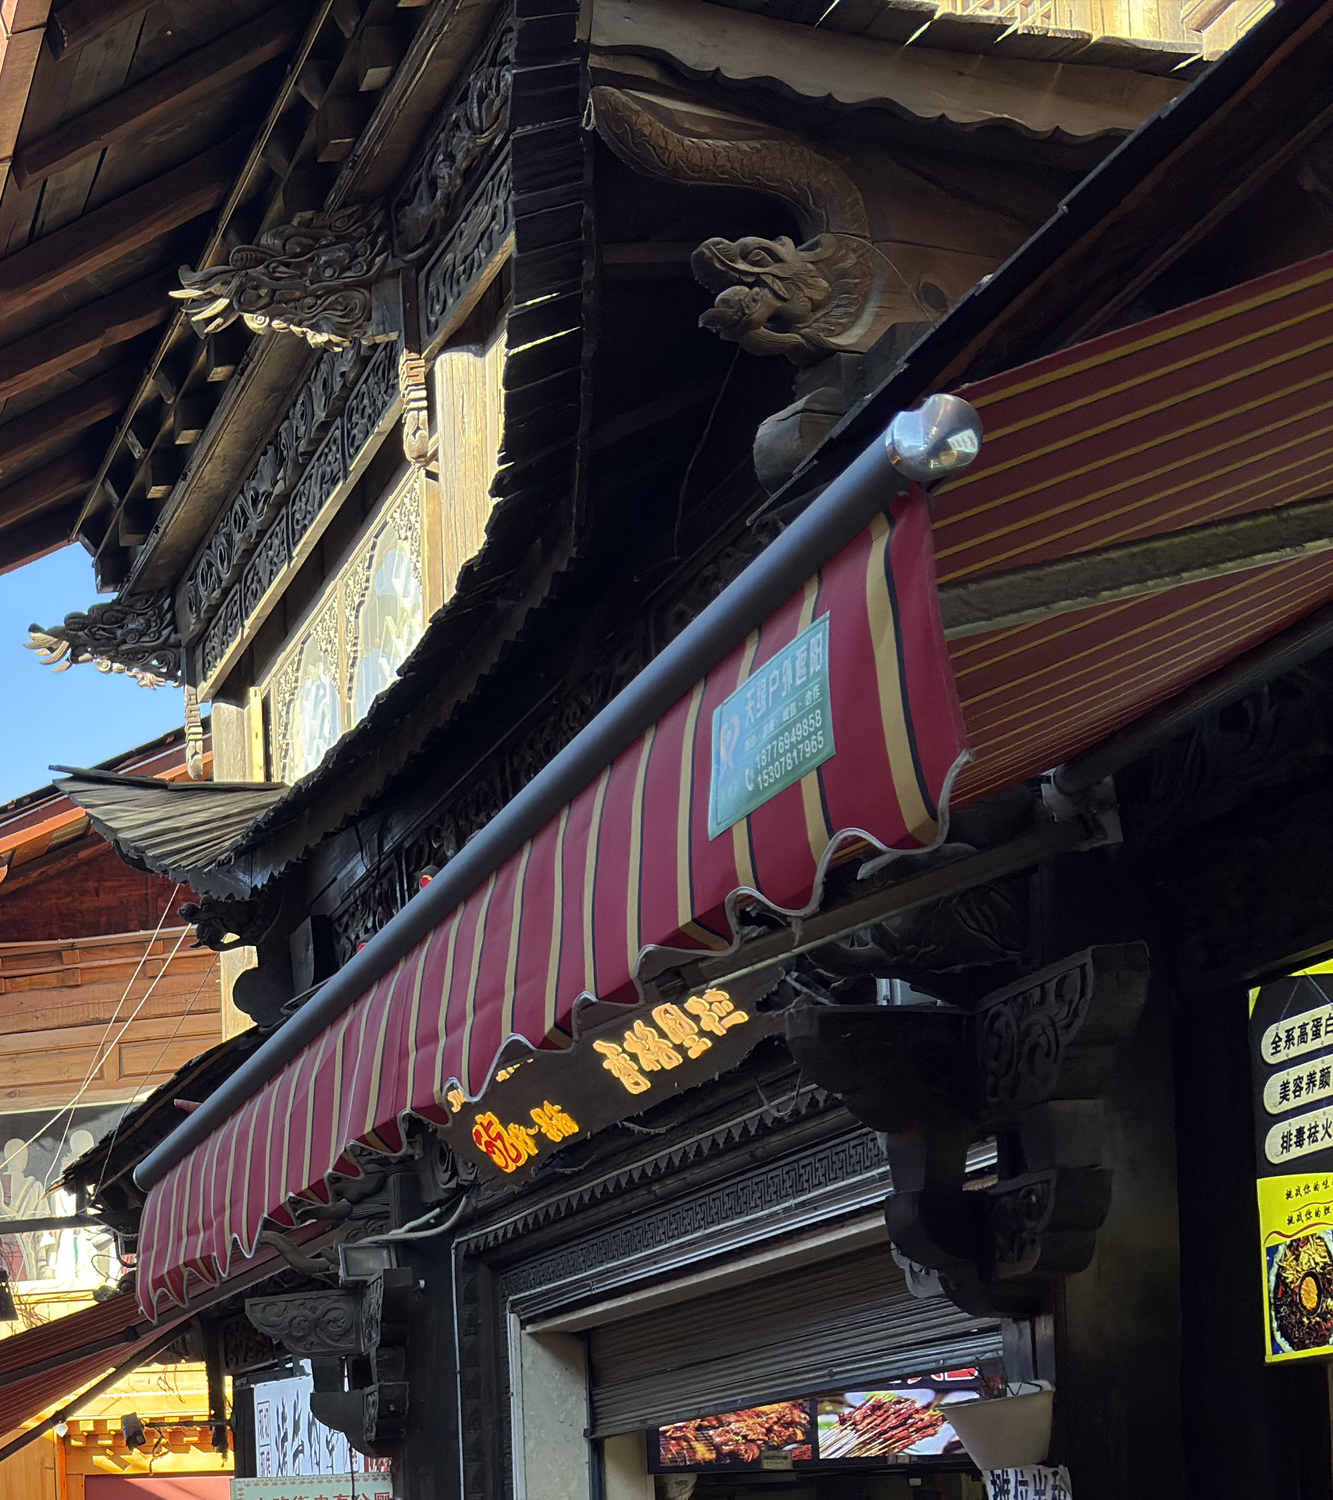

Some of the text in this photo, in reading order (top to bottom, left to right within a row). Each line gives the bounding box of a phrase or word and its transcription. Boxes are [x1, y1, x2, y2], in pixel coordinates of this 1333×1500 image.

[1270, 1014, 1333, 1055] 全系高蛋白
[1278, 1065, 1331, 1103] 美容养颜
[1280, 1116, 1332, 1154] 排毒祛火
[1285, 1177, 1333, 1200] 挑战你的味
